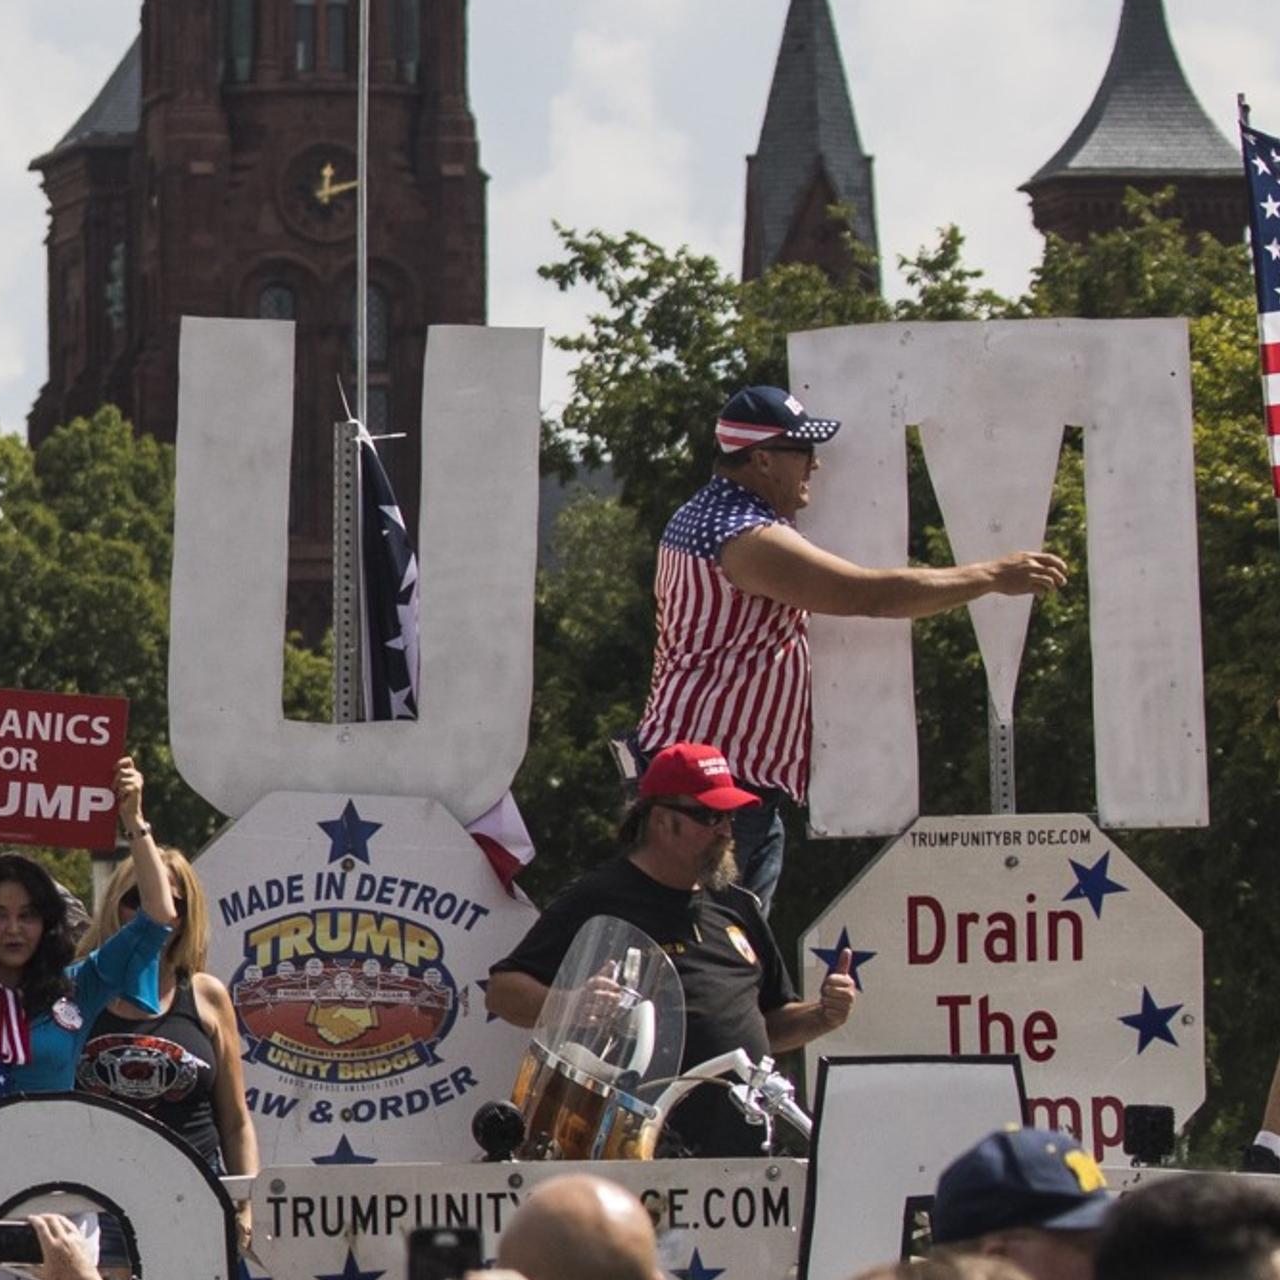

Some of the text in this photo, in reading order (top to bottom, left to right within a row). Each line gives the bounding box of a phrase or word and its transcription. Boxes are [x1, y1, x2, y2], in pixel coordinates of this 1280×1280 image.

[909, 828, 1092, 848] TRUMPUNITYBRDGE.COM
[219, 872, 489, 931] MADE IN DETROIT
[906, 894, 1084, 965] Drain
[249, 911, 440, 968] TRUMP
[937, 995, 1059, 1063] The
[267, 1048, 419, 1080] UNITY BRIDGE
[244, 1066, 479, 1124] AW & ORDER
[267, 1187, 791, 1238] TRUMPUNITE.COM
